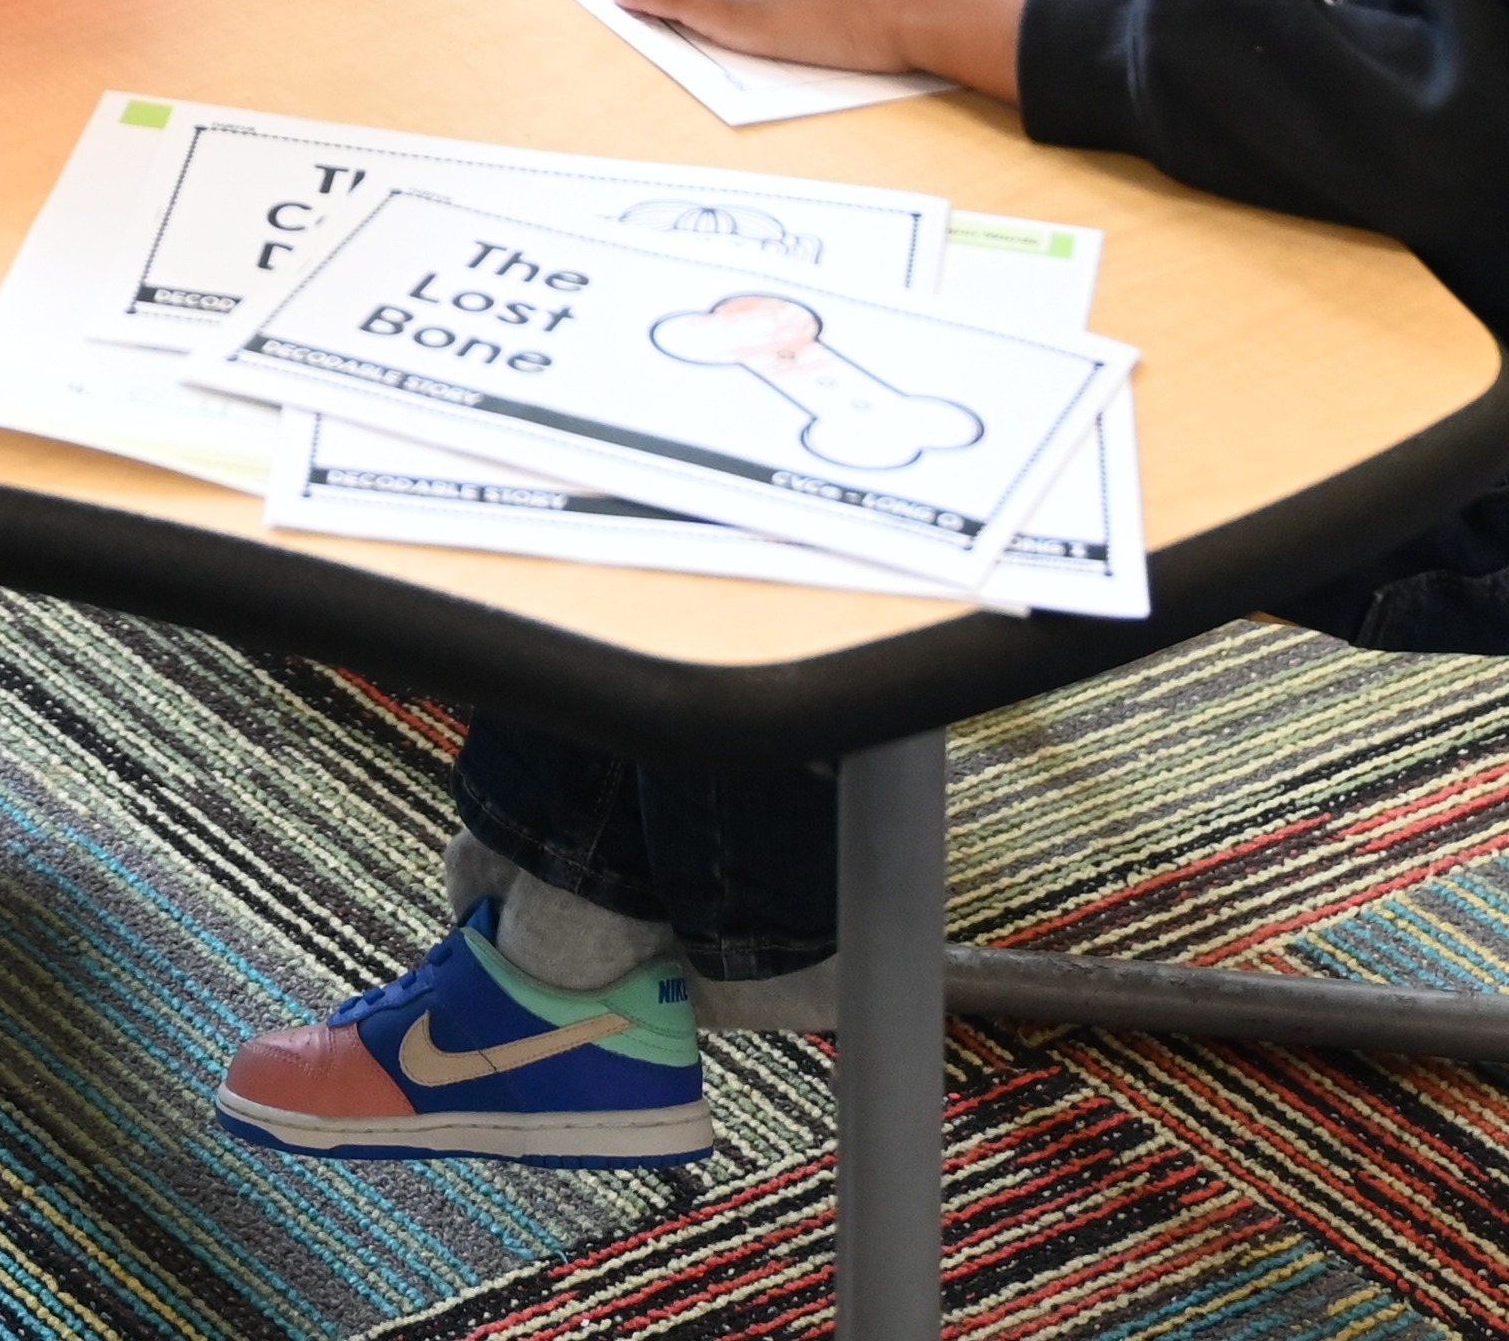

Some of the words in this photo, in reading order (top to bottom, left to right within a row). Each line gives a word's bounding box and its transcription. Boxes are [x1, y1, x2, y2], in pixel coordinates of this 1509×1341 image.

[465, 240, 591, 292] The
[407, 272, 577, 334] Lost
[358, 303, 553, 373] Bone
[261, 338, 403, 389] DECODABLE
[402, 374, 482, 407] STORY
[326, 470, 479, 502] DECODABLE
[484, 486, 569, 510] STORY
[861, 492, 937, 524] LONG
[1009, 533, 1068, 557] ONG
